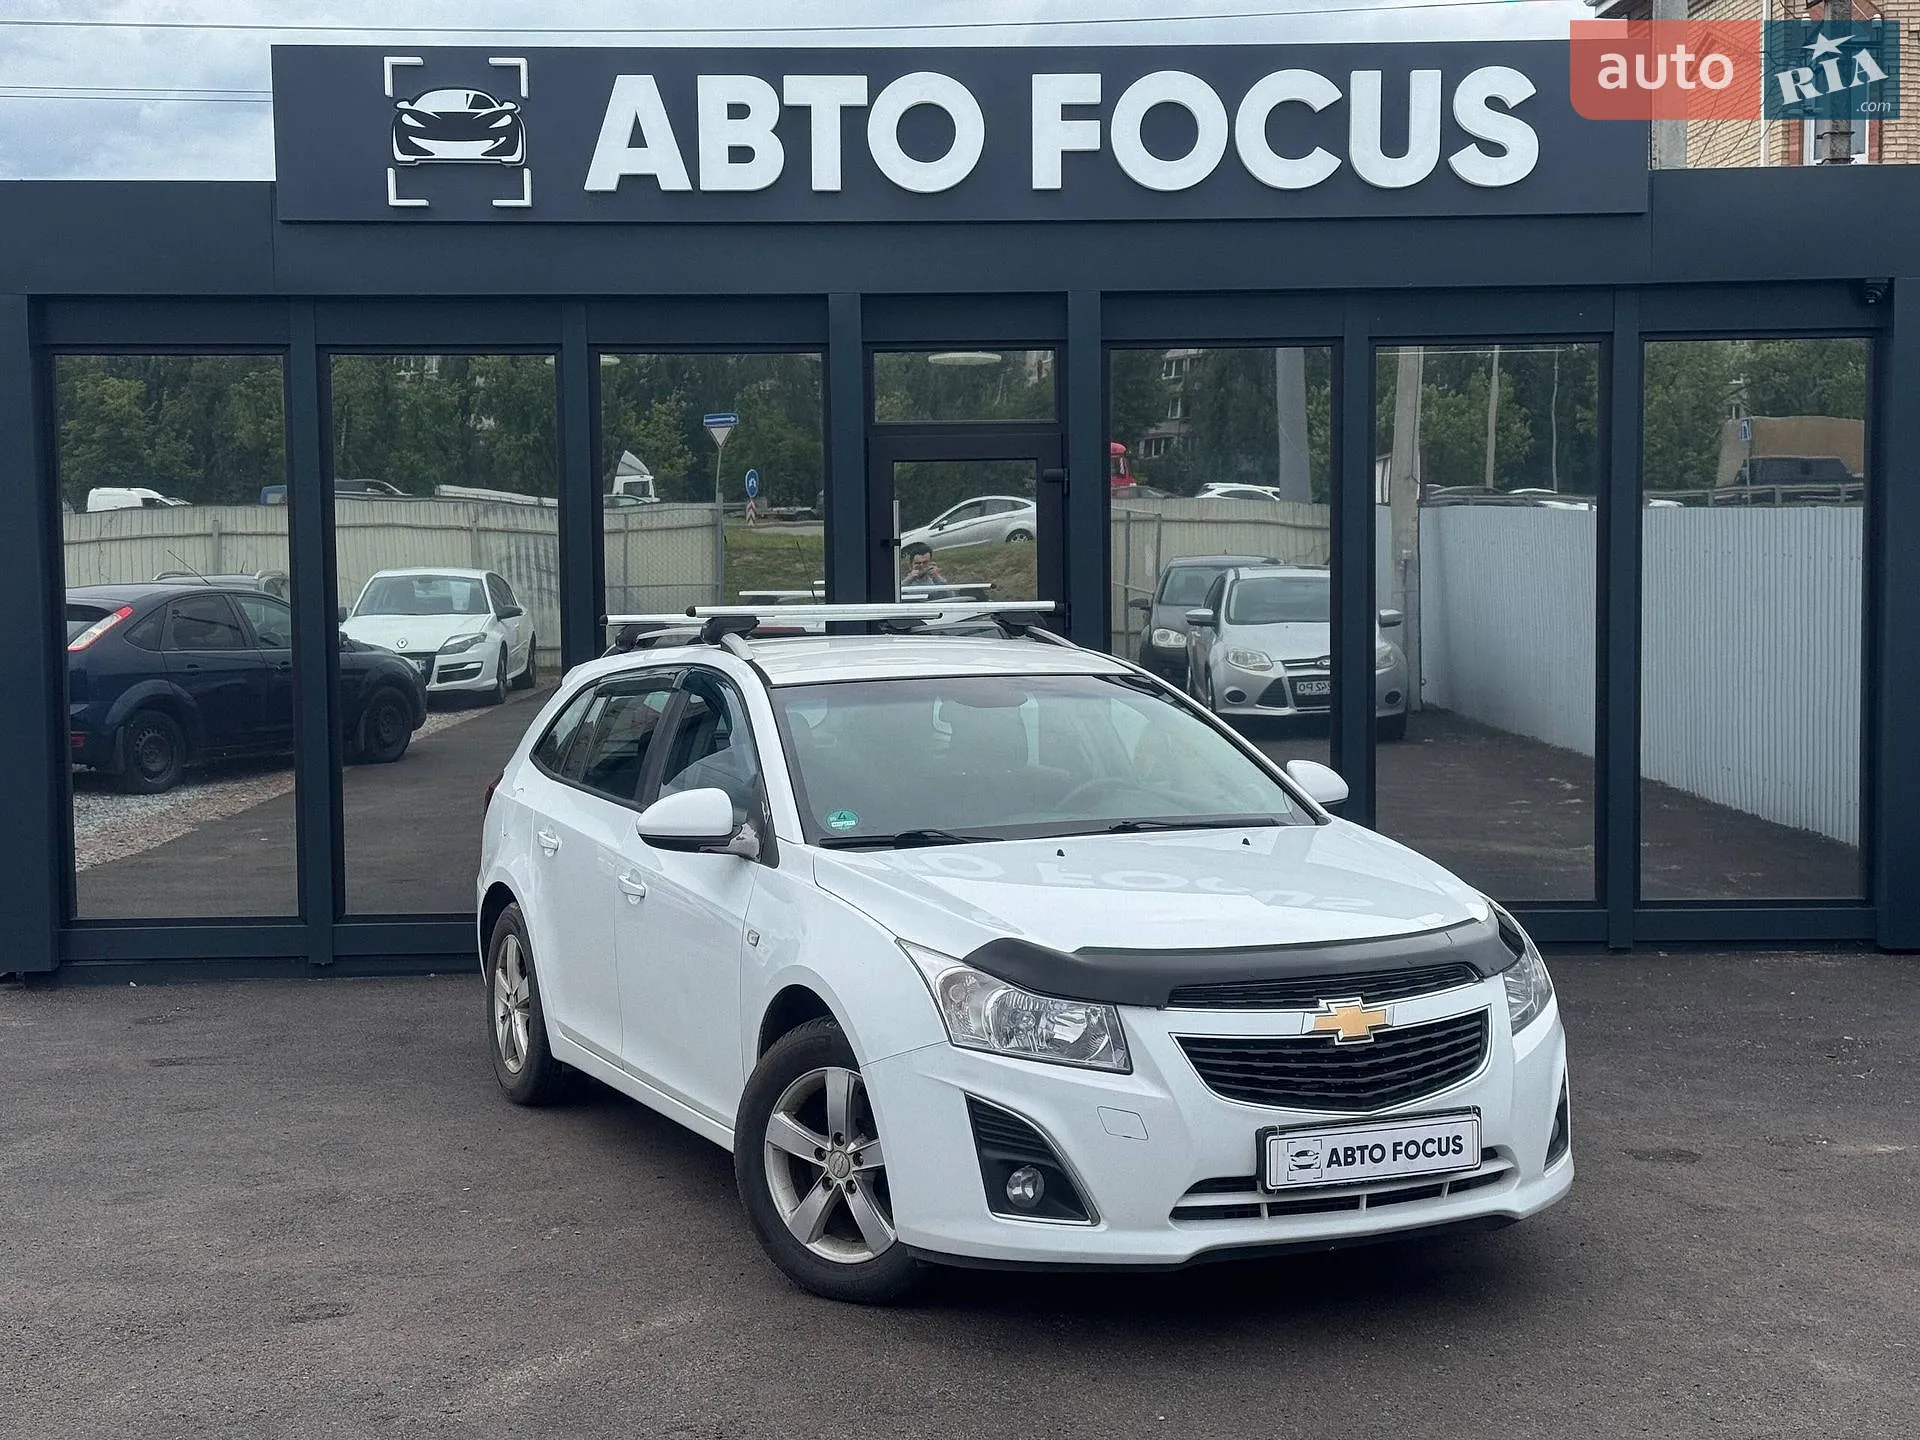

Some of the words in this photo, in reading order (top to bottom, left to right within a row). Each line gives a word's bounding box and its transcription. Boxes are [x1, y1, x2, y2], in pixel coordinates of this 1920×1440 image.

[584, 71, 985, 193] АВТО
[1031, 66, 1540, 190] FOCUS
[1326, 1143, 1386, 1169] АВТО
[1392, 1135, 1463, 1162] FOCUS
